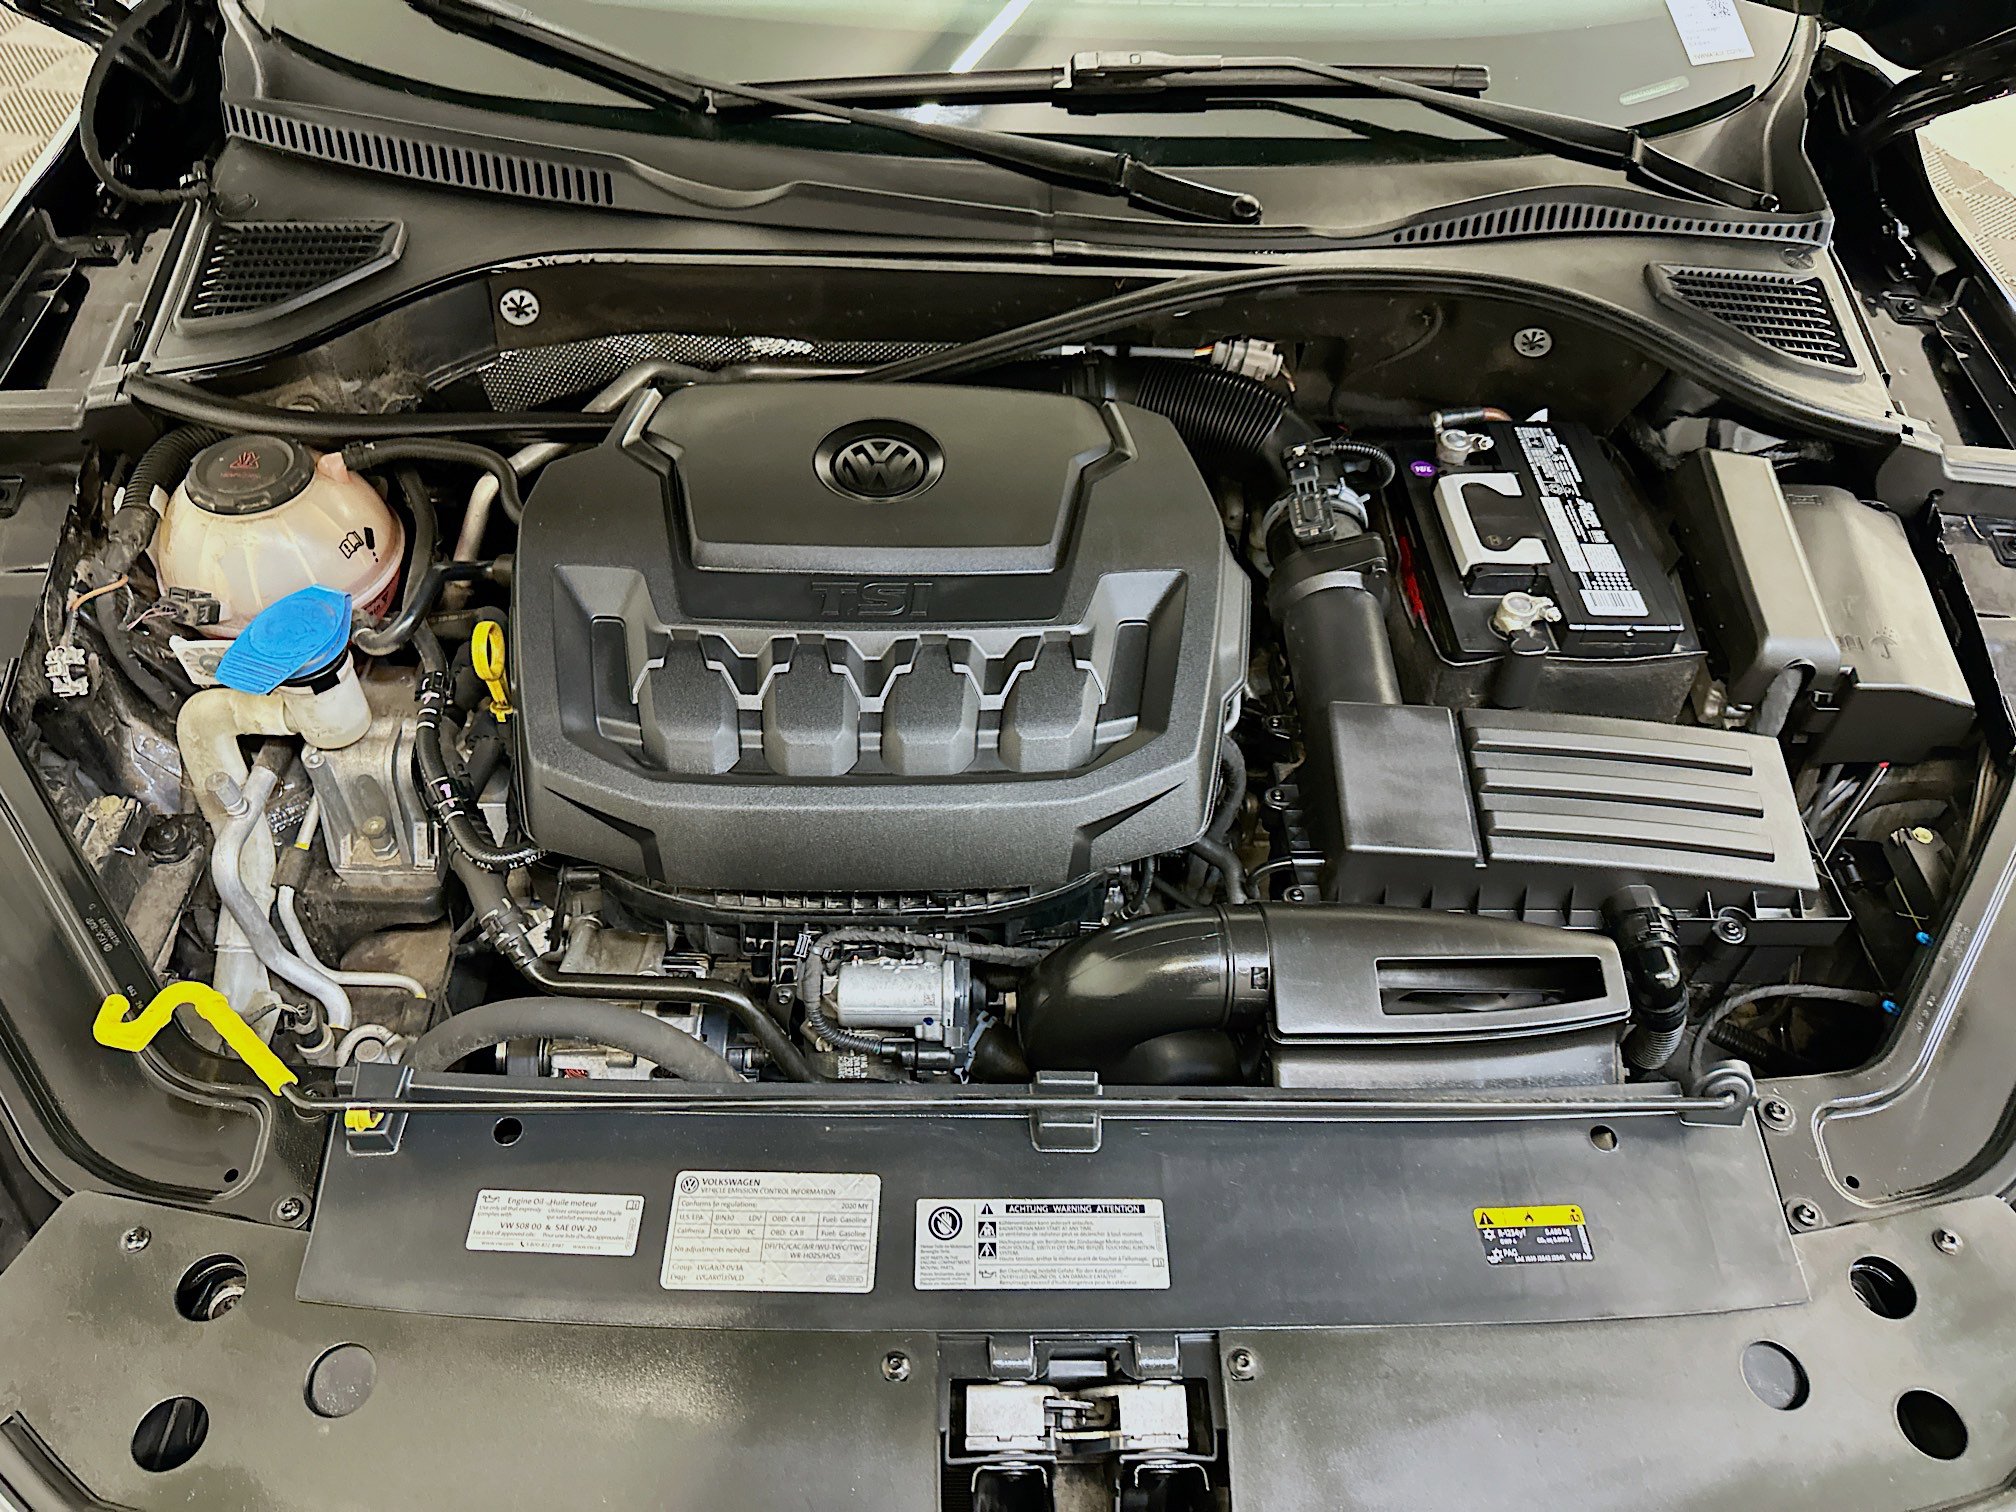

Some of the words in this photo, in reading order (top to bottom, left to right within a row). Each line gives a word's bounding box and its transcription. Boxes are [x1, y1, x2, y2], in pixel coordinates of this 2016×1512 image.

[812, 582, 933, 616] TSI
[702, 1178, 761, 1186] VOLKSWAGEN
[507, 1197, 532, 1206] Engine
[549, 1199, 569, 1207] Huile
[1008, 1204, 1049, 1213] ACHTUNG
[1052, 1204, 1092, 1213] WARNING
[1096, 1204, 1140, 1213] ATTENTION
[515, 1222, 530, 1230] 508
